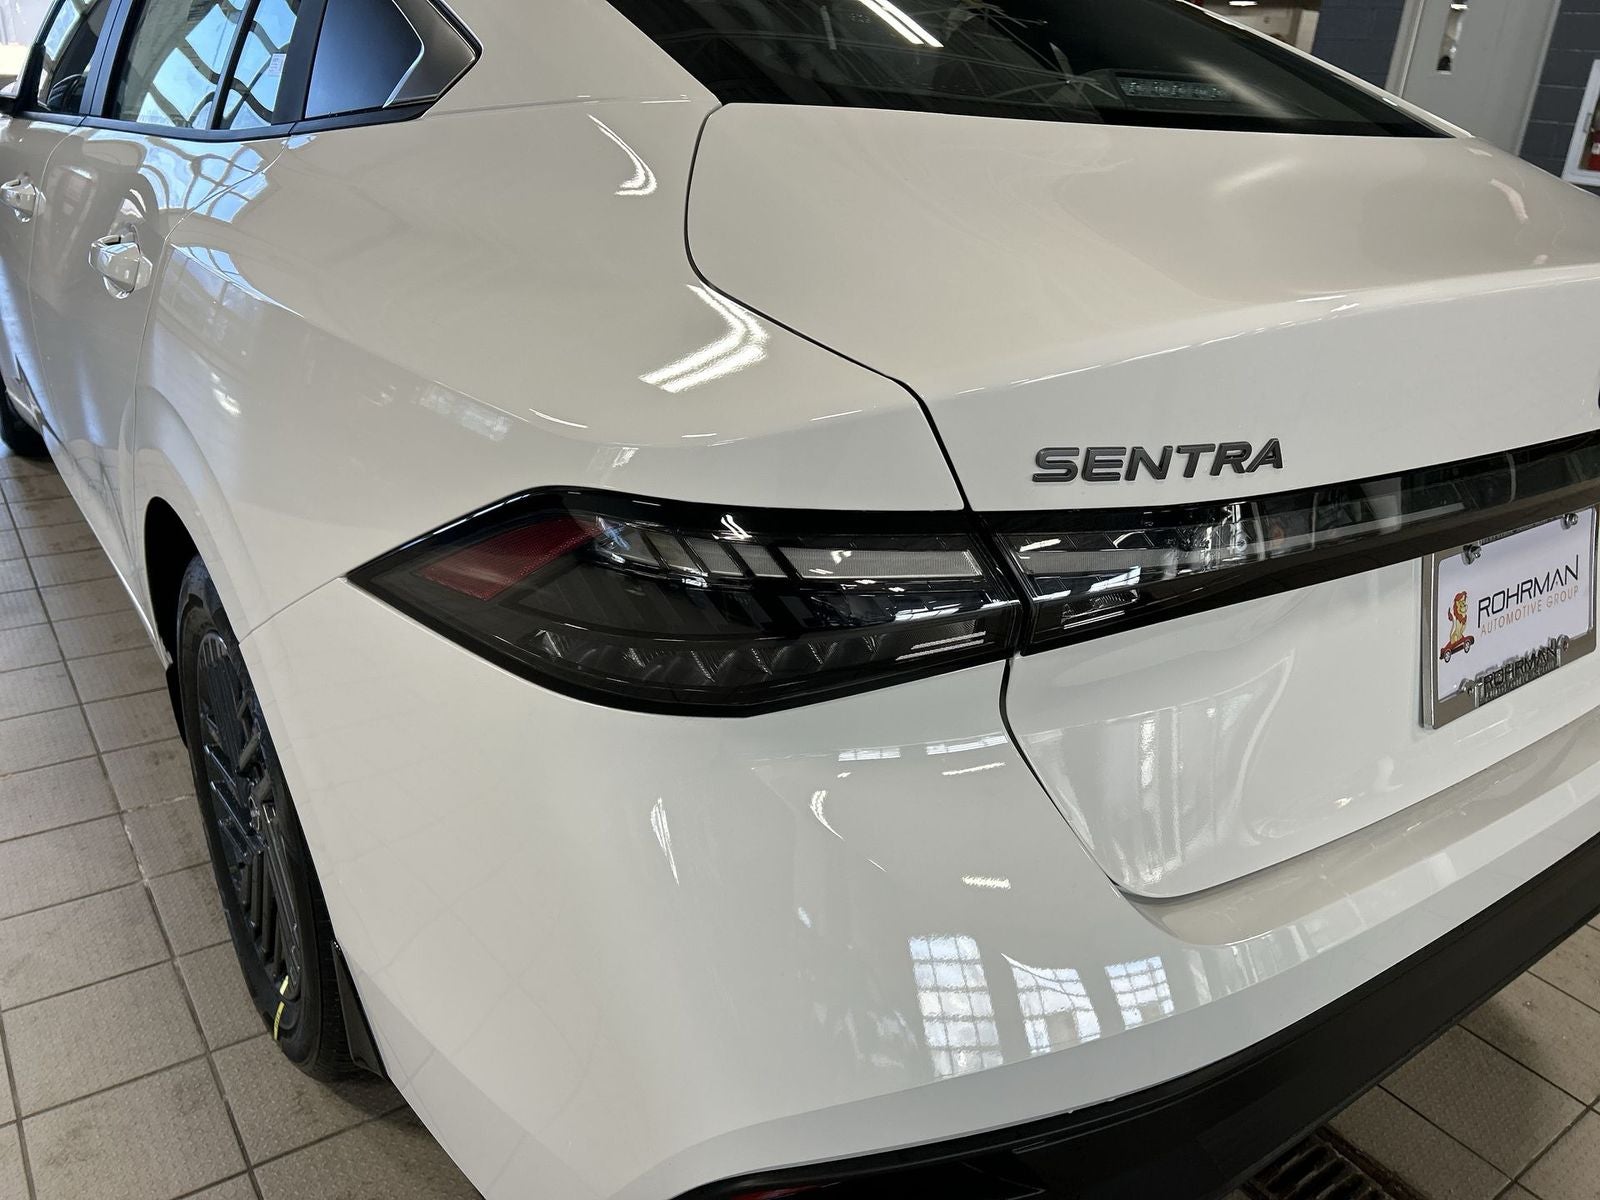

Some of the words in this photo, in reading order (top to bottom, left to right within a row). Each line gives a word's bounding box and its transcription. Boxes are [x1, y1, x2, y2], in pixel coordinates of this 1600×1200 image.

[1032, 438, 1283, 482] SENTRA
[1478, 554, 1579, 629] ROHRMAN
[1481, 599, 1542, 636] AUTOMOTIVE
[1546, 585, 1579, 608] GROUP
